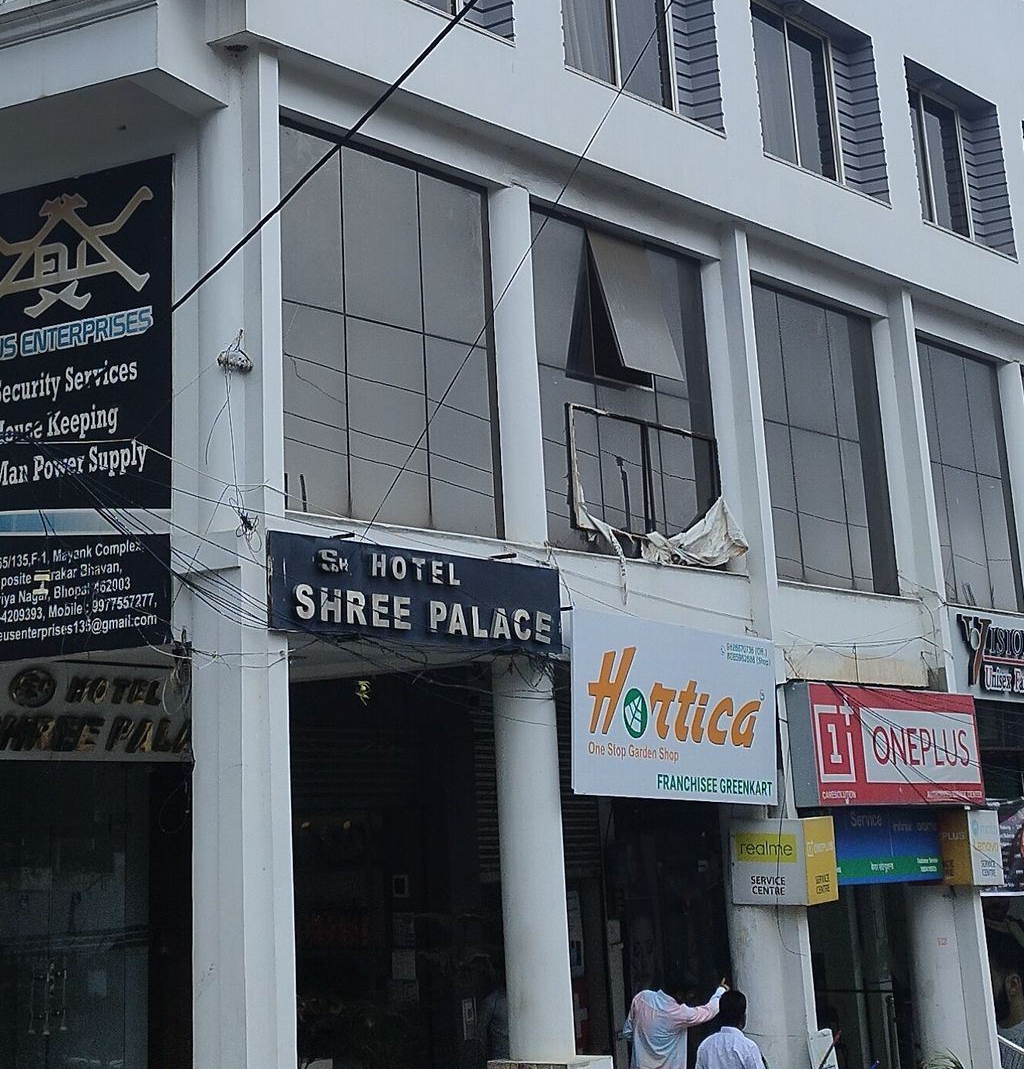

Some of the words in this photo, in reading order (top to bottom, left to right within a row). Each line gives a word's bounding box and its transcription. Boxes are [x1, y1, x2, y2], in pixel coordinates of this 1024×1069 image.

[21, 306, 153, 356] ENTERPRISES
[0, 372, 60, 403] ecurity
[65, 359, 138, 392] Services
[47, 404, 119, 439] Keeping
[33, 455, 85, 481] Power
[89, 440, 147, 477] Supply
[53, 545, 92, 564] Mayank
[81, 562, 122, 577] Bhavan,
[371, 553, 461, 586] HOTEL
[49, 602, 83, 618] Mobile
[295, 583, 412, 631] SHREE
[430, 600, 552, 645] PALACE
[985, 665, 1012, 691] Unisex
[65, 676, 162, 706] HOTEL
[588, 742, 605, 755] One
[607, 743, 626, 760] Stop
[628, 745, 657, 760] Garden
[658, 747, 679, 764] Shop
[873, 725, 970, 767] ONEPLUS
[657, 774, 718, 793] FRANCHISEE
[720, 778, 772, 797] GREENKART
[850, 811, 882, 828] Service
[740, 841, 793, 857] realme
[751, 875, 786, 886] SERVICE
[752, 885, 786, 895] CENTRE
